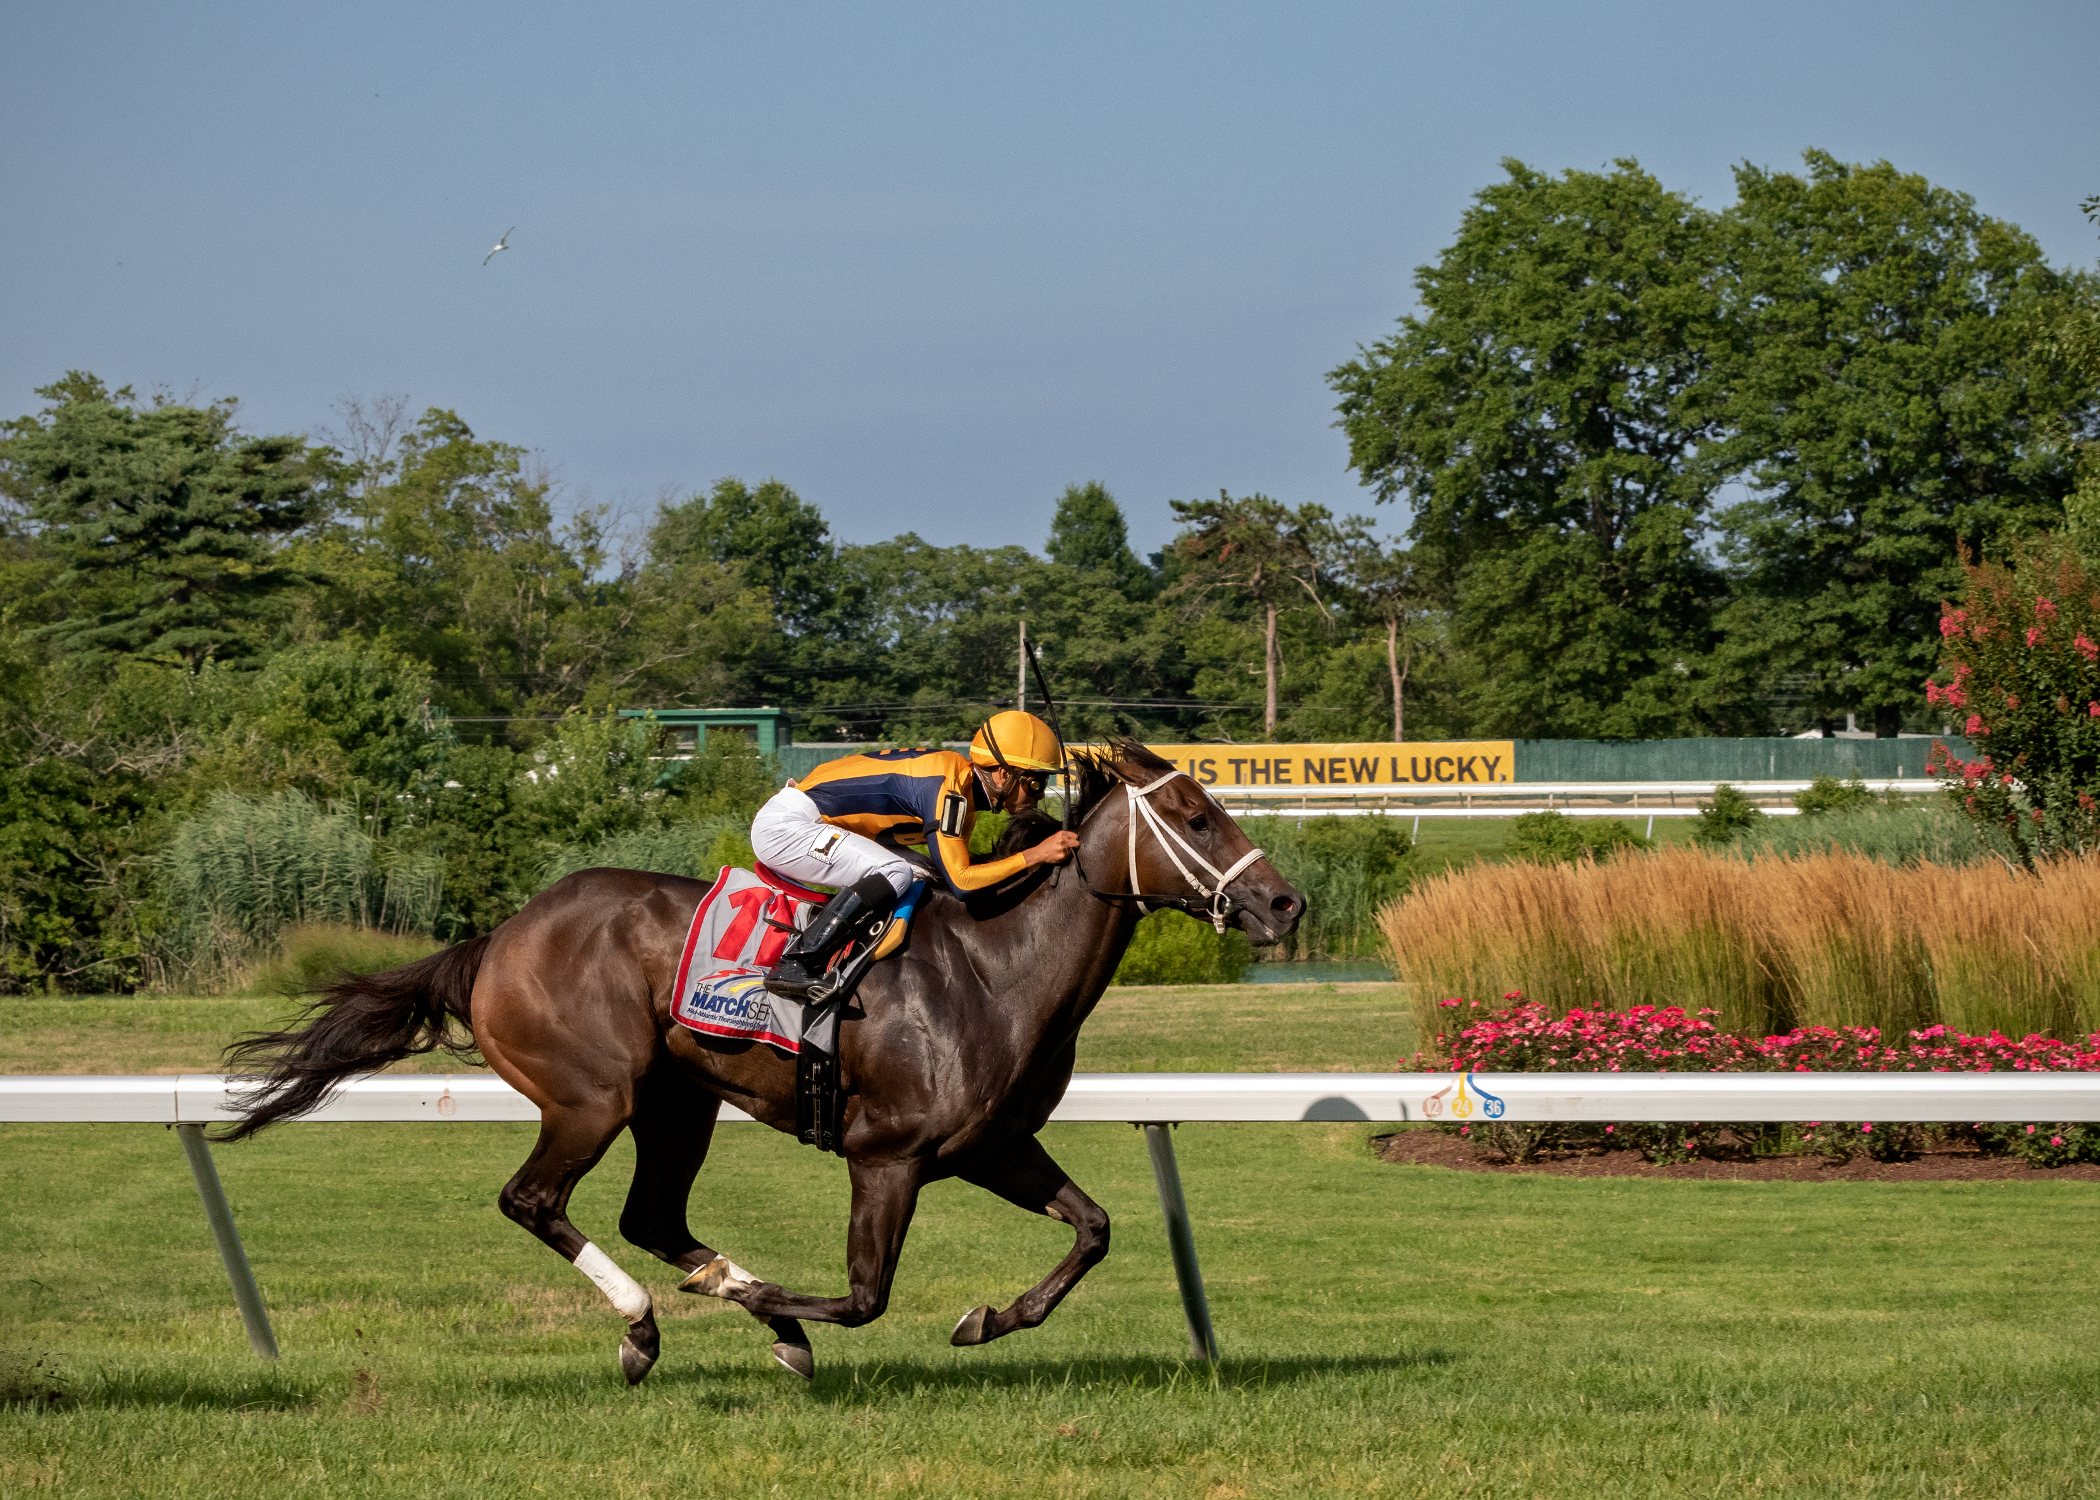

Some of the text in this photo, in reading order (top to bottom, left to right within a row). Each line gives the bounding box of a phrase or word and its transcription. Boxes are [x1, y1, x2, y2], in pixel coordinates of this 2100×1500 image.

[1189, 759, 1218, 785] IS
[1227, 758, 1292, 784] THE
[1304, 757, 1380, 784] NEW
[1390, 756, 1506, 783] LUCKY.
[810, 850, 830, 863] GUILD
[695, 982, 712, 994] THE
[1454, 1099, 1470, 1115] 24
[1486, 1099, 1502, 1116] 36
